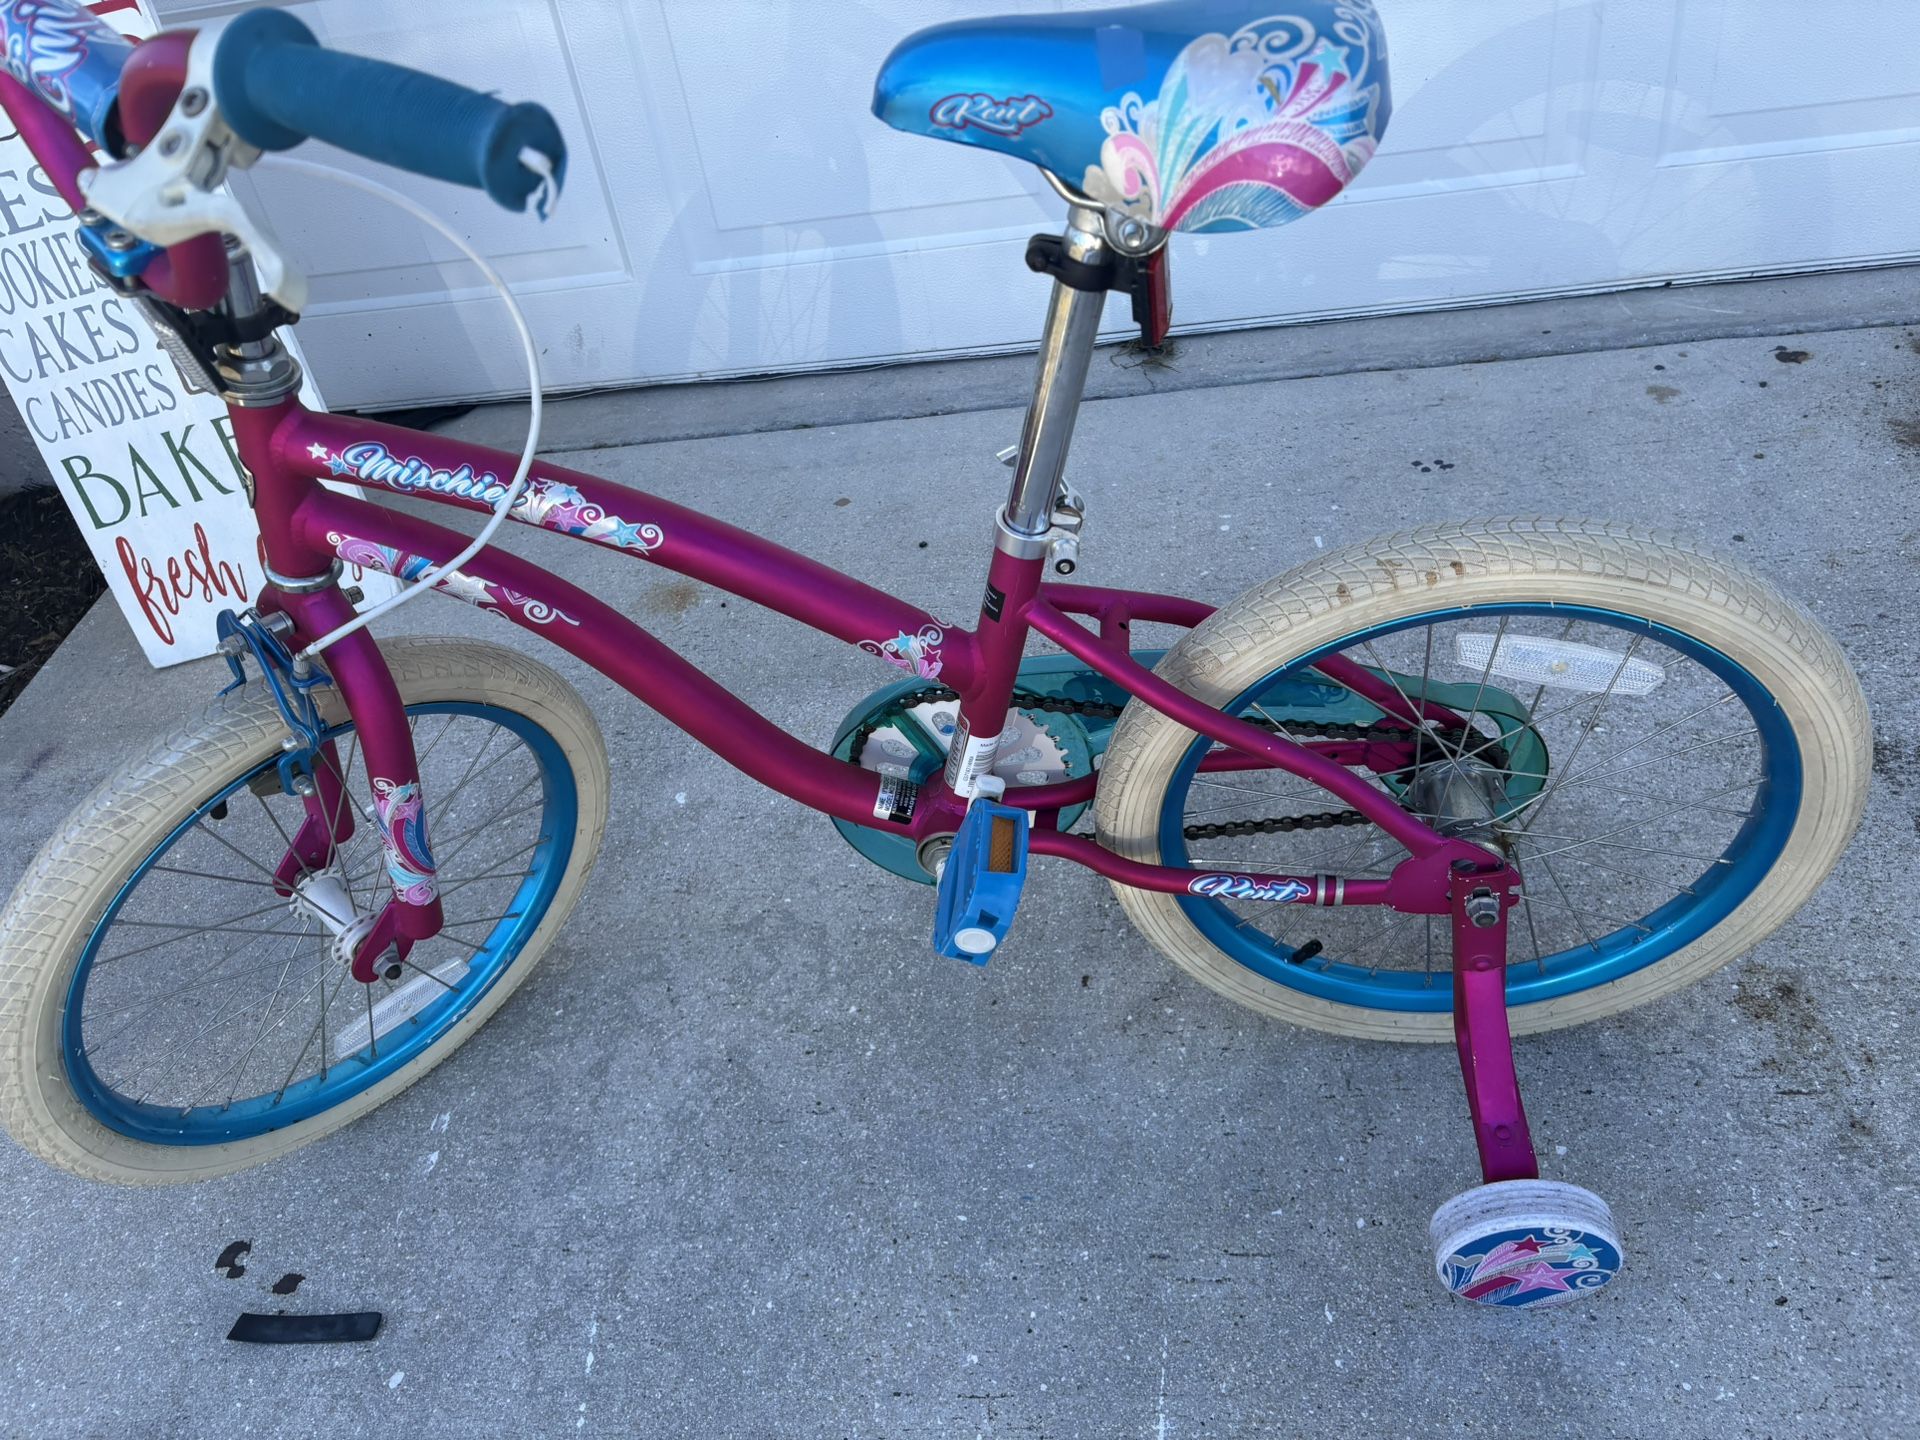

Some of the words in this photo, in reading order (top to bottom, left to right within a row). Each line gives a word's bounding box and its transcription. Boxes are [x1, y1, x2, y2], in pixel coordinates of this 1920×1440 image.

[931, 95, 1052, 135] Kent
[25, 364, 177, 443] CANDIES
[116, 523, 247, 645] fresh
[1189, 874, 1310, 902] Kent
